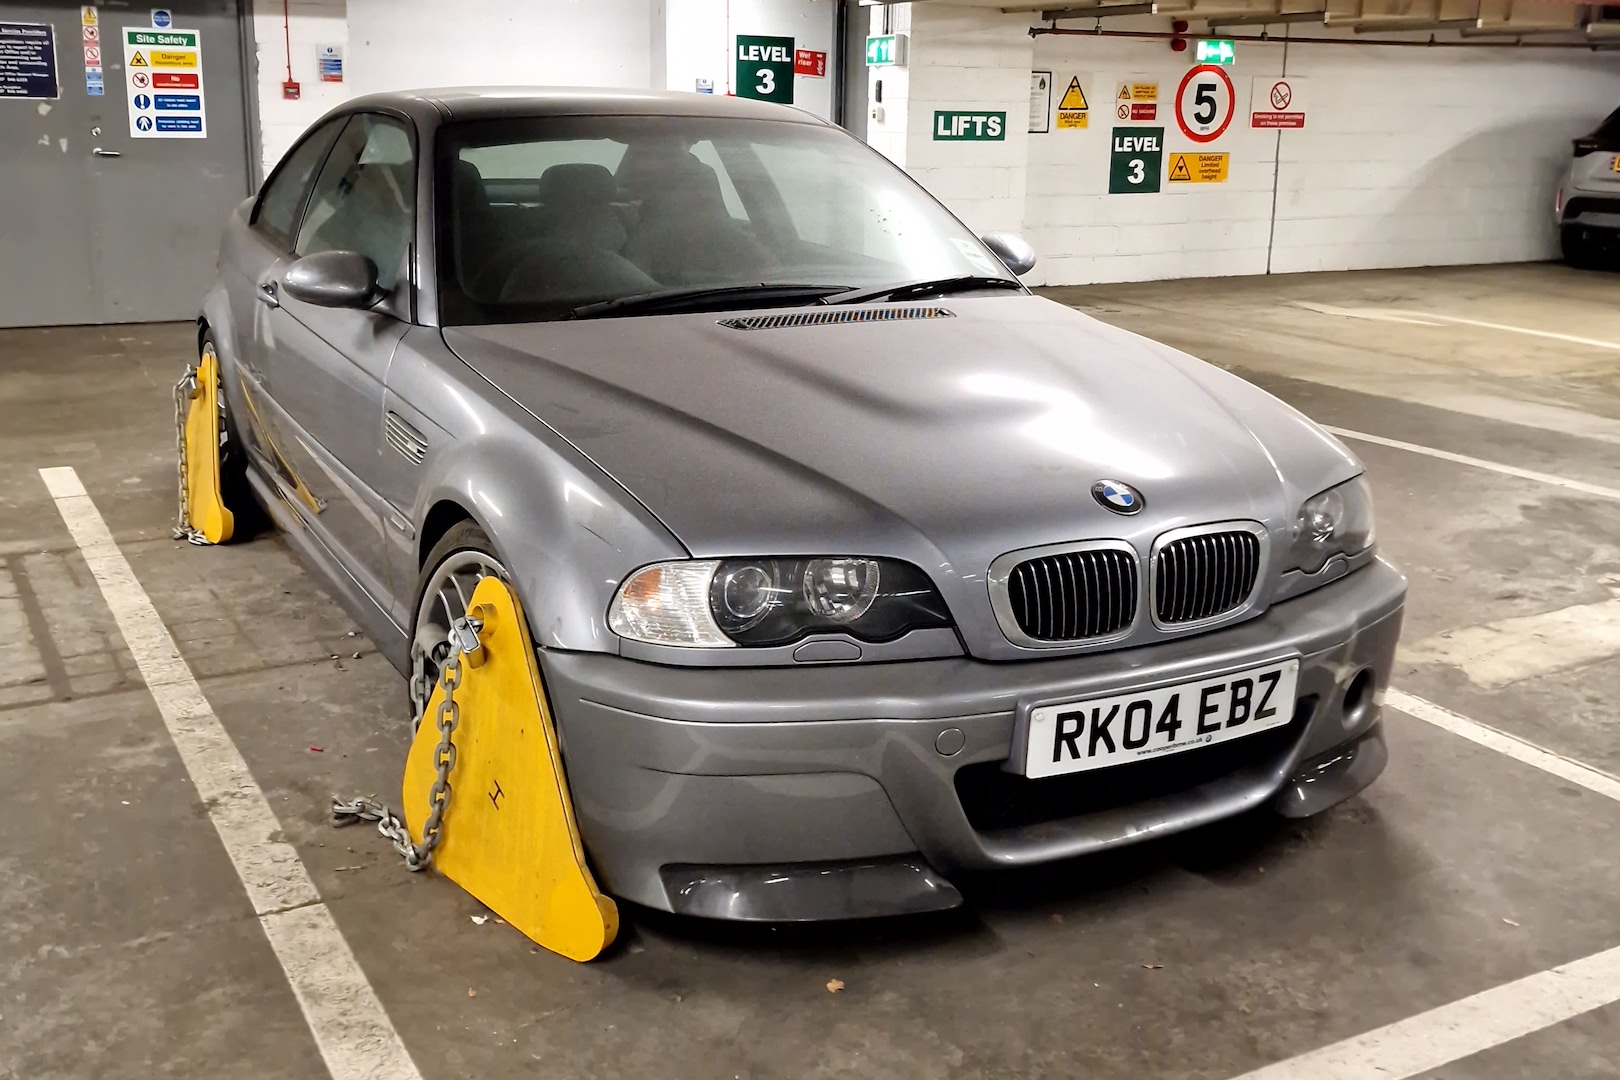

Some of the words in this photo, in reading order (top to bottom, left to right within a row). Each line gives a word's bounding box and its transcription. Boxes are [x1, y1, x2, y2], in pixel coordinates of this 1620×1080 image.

[136, 34, 155, 43] Site
[158, 35, 188, 46] Safety
[739, 45, 791, 62] LEVEL
[756, 69, 775, 94] 3
[1194, 84, 1217, 124] 5
[938, 116, 1001, 136] LIFTS
[1114, 137, 1160, 152] LEVEL
[1127, 159, 1145, 184] 3
[1052, 693, 1182, 762] RK04
[1197, 670, 1282, 736] EBZ
